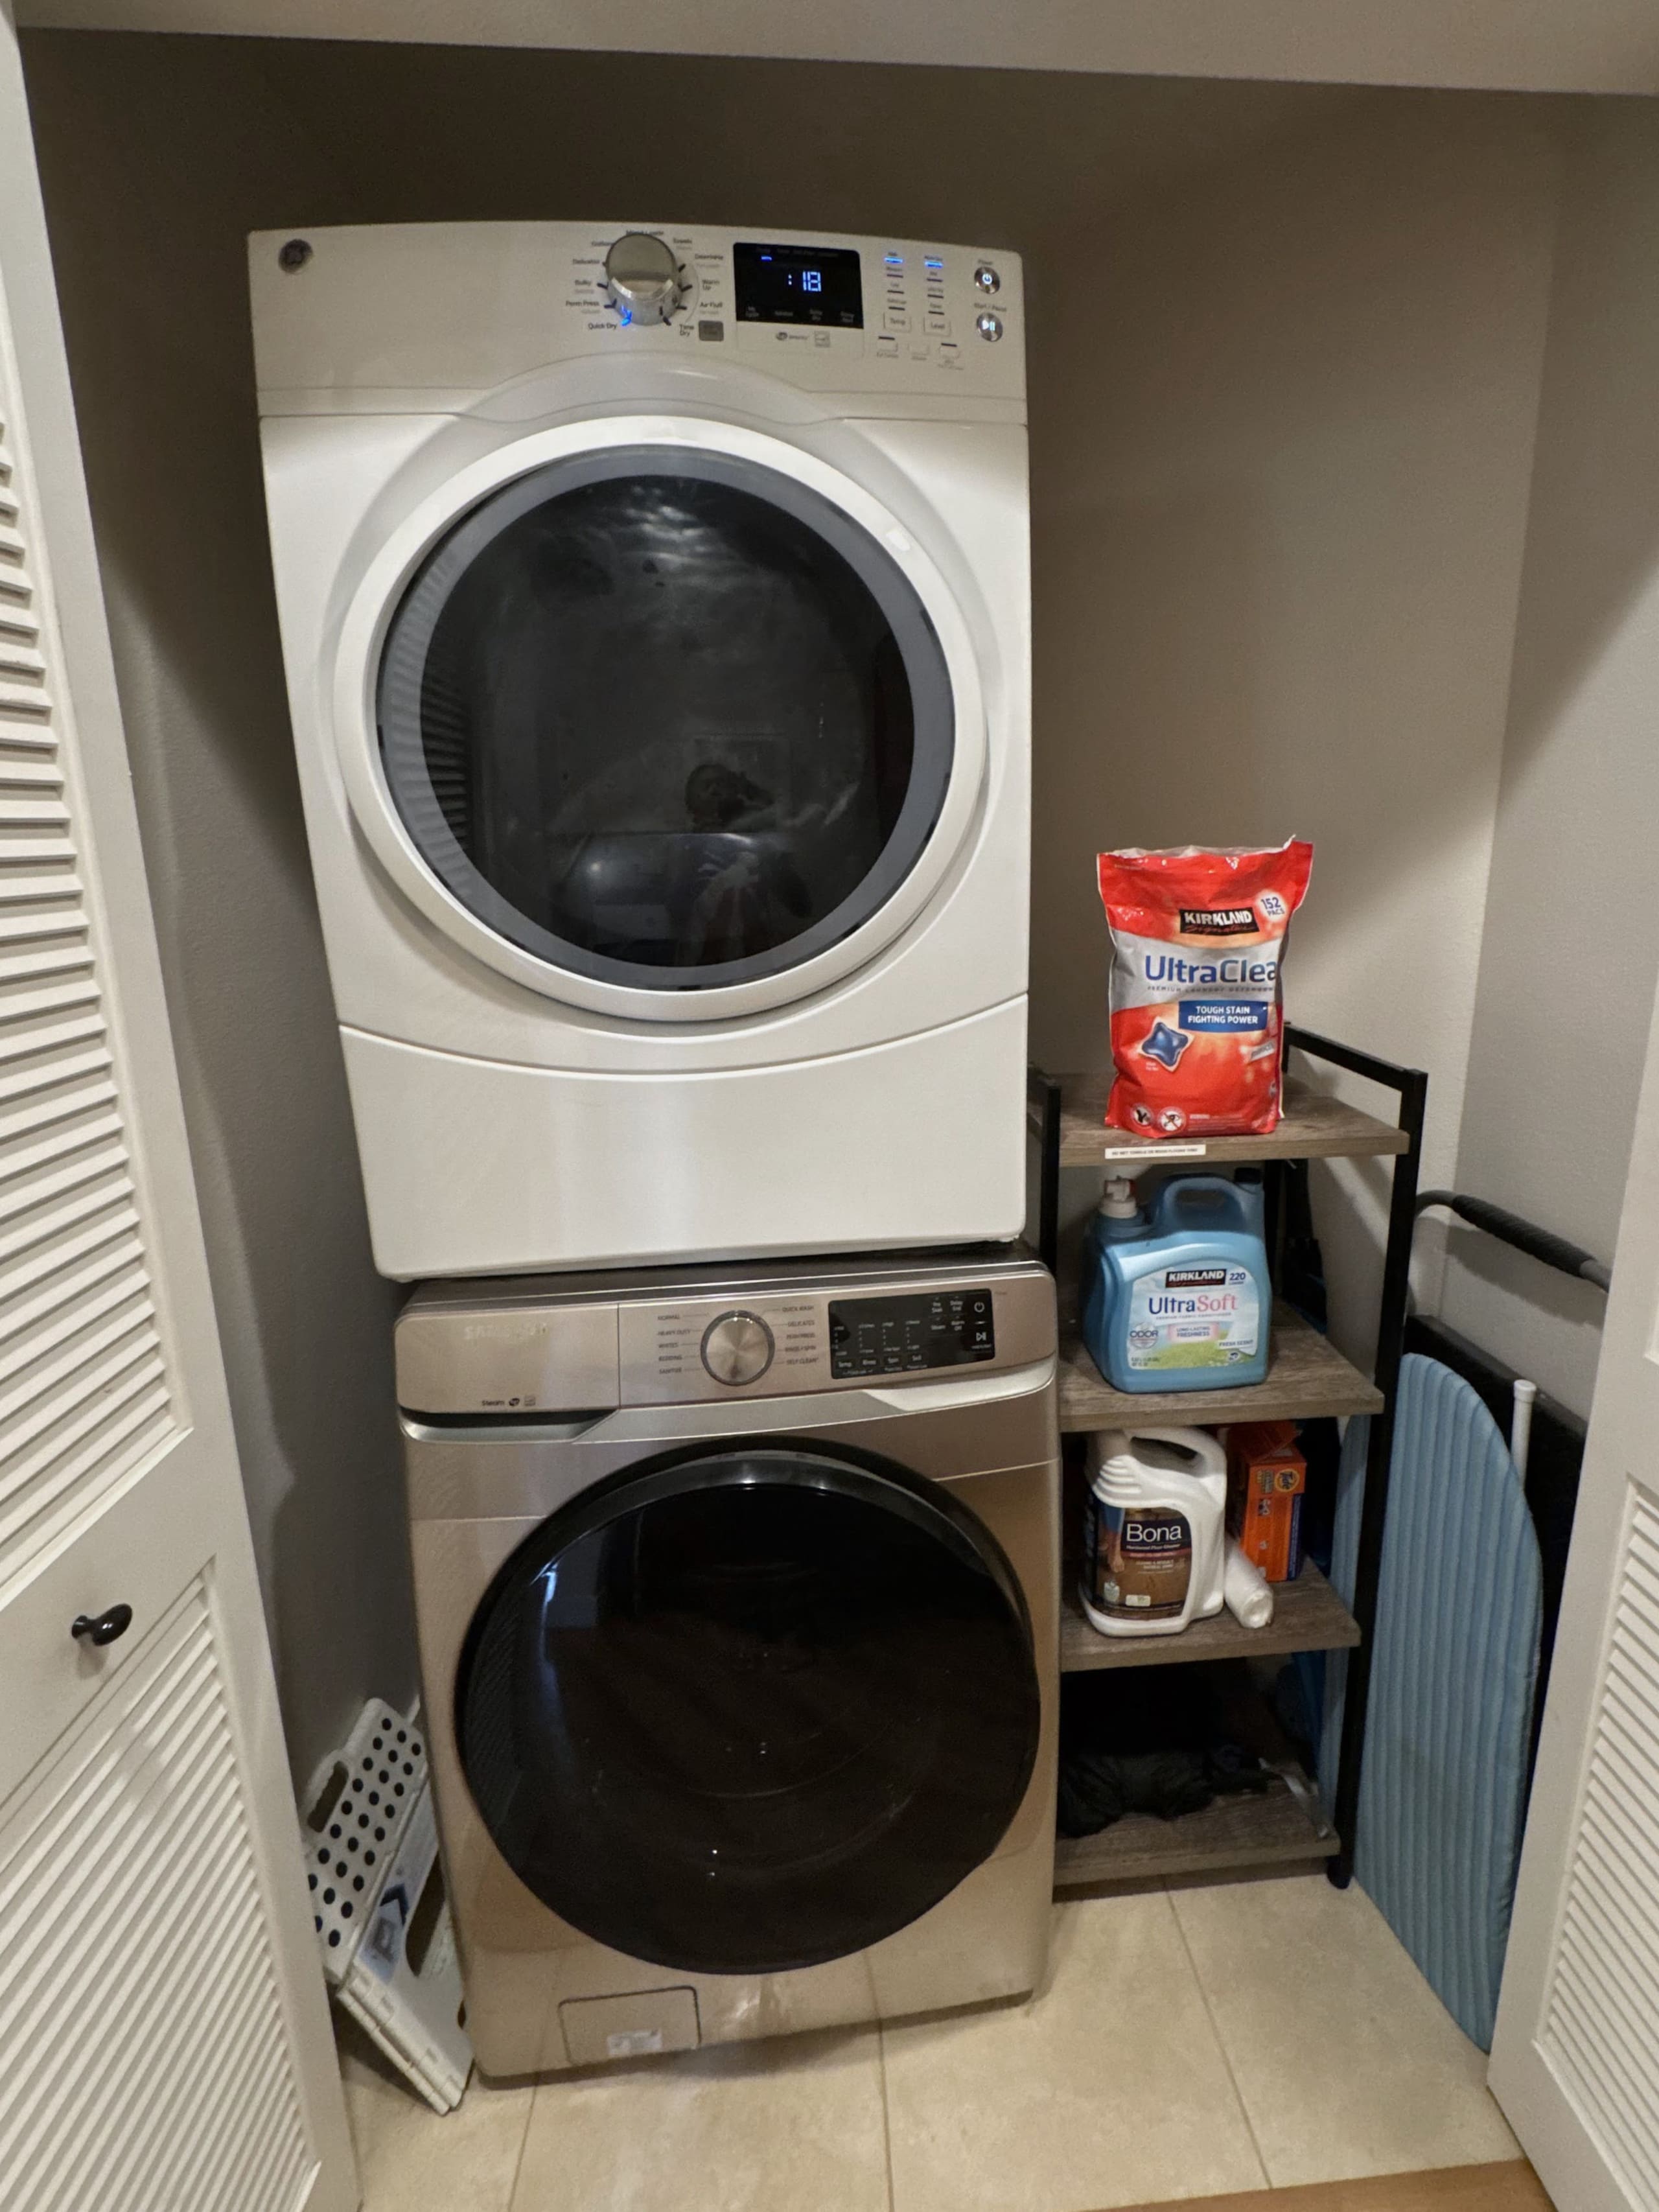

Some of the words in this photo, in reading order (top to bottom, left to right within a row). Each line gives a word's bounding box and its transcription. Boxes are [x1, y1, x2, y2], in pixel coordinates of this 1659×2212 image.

[1260, 896, 1281, 910] 152
[1183, 910, 1253, 926] KIRKLAND
[1144, 955, 1277, 984] UltraClea
[1196, 1005, 1224, 1014] TOUGH
[1225, 1005, 1250, 1014] STAIN
[1187, 1015, 1226, 1024] FIGHTING
[1227, 1015, 1259, 1024] POWER
[1168, 1270, 1225, 1282] KIRKLAND
[1229, 1272, 1246, 1281] 220
[1148, 1293, 1238, 1315] UltraSoft
[1126, 1523, 1183, 1543] Bona
